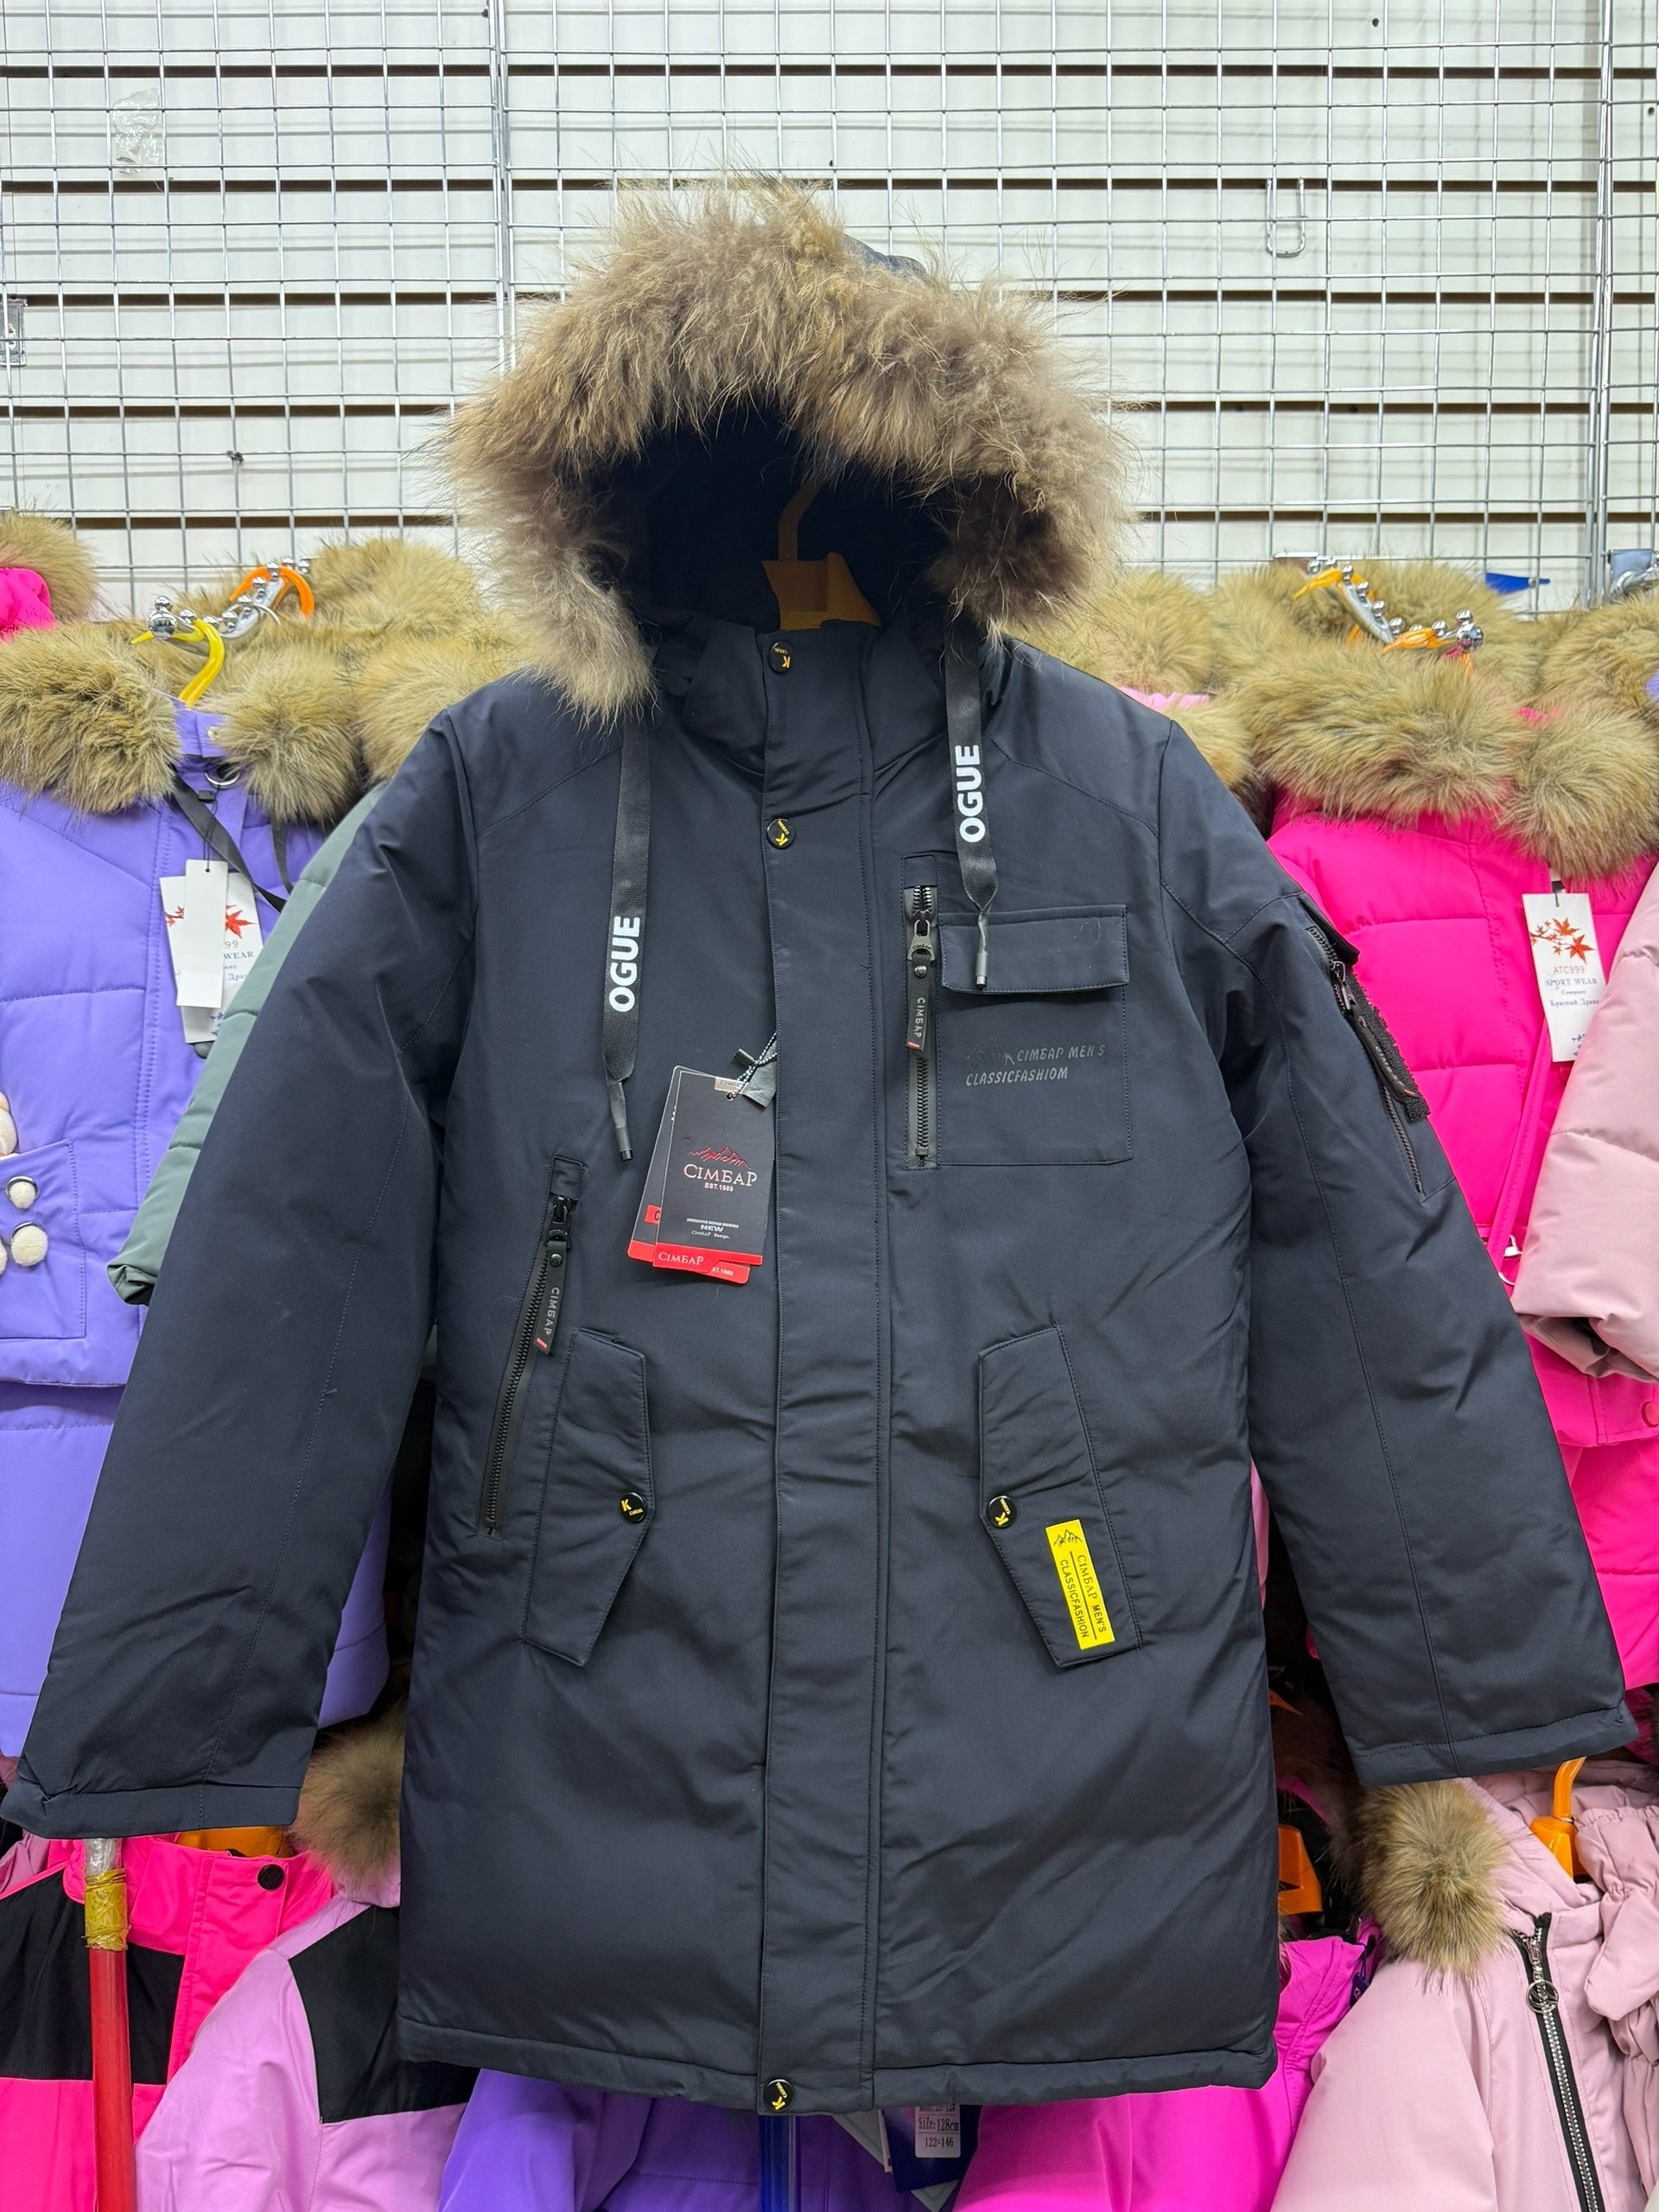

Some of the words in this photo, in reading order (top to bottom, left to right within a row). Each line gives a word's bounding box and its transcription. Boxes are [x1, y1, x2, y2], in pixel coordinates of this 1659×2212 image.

[955, 745, 986, 843] OGUE
[608, 916, 640, 1012] OGUE
[1553, 965, 1585, 975] ATC999
[700, 1224, 724, 1232] NEW
[621, 1498, 632, 1512] K
[1059, 1559, 1090, 1638] CLASSICFASHION
[1092, 1604, 1107, 1633] MEN'S
